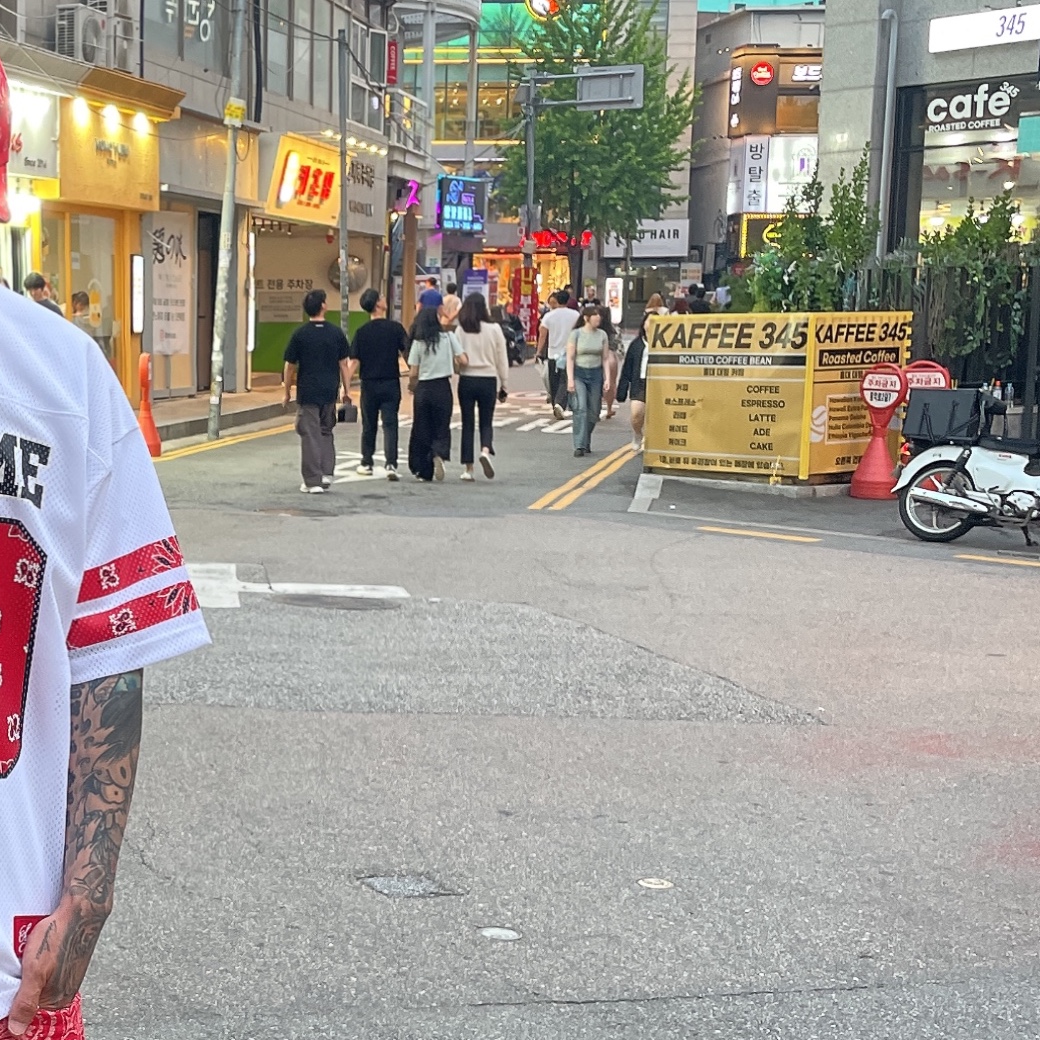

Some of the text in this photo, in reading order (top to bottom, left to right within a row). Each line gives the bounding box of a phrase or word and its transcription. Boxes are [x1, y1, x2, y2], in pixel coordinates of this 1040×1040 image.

[995, 12, 1028, 38] 345
[999, 81, 1020, 98] 345
[928, 118, 1001, 133] ROASTED COFFEE
[650, 229, 680, 240] HAIR
[287, 279, 313, 290] 주차장
[651, 321, 808, 349] KAFFEE 345
[815, 322, 908, 343] KAFFEE 345
[679, 355, 772, 365] ROASTED COFFEE BEAN
[822, 350, 897, 365] Roasted Coffee
[868, 378, 897, 388] 주차금지
[746, 385, 780, 394] COFFEE
[741, 399, 785, 409] ESPRESSO
[749, 413, 776, 422] LATTE
[753, 428, 771, 436] ADE
[749, 442, 773, 451] CAKE
